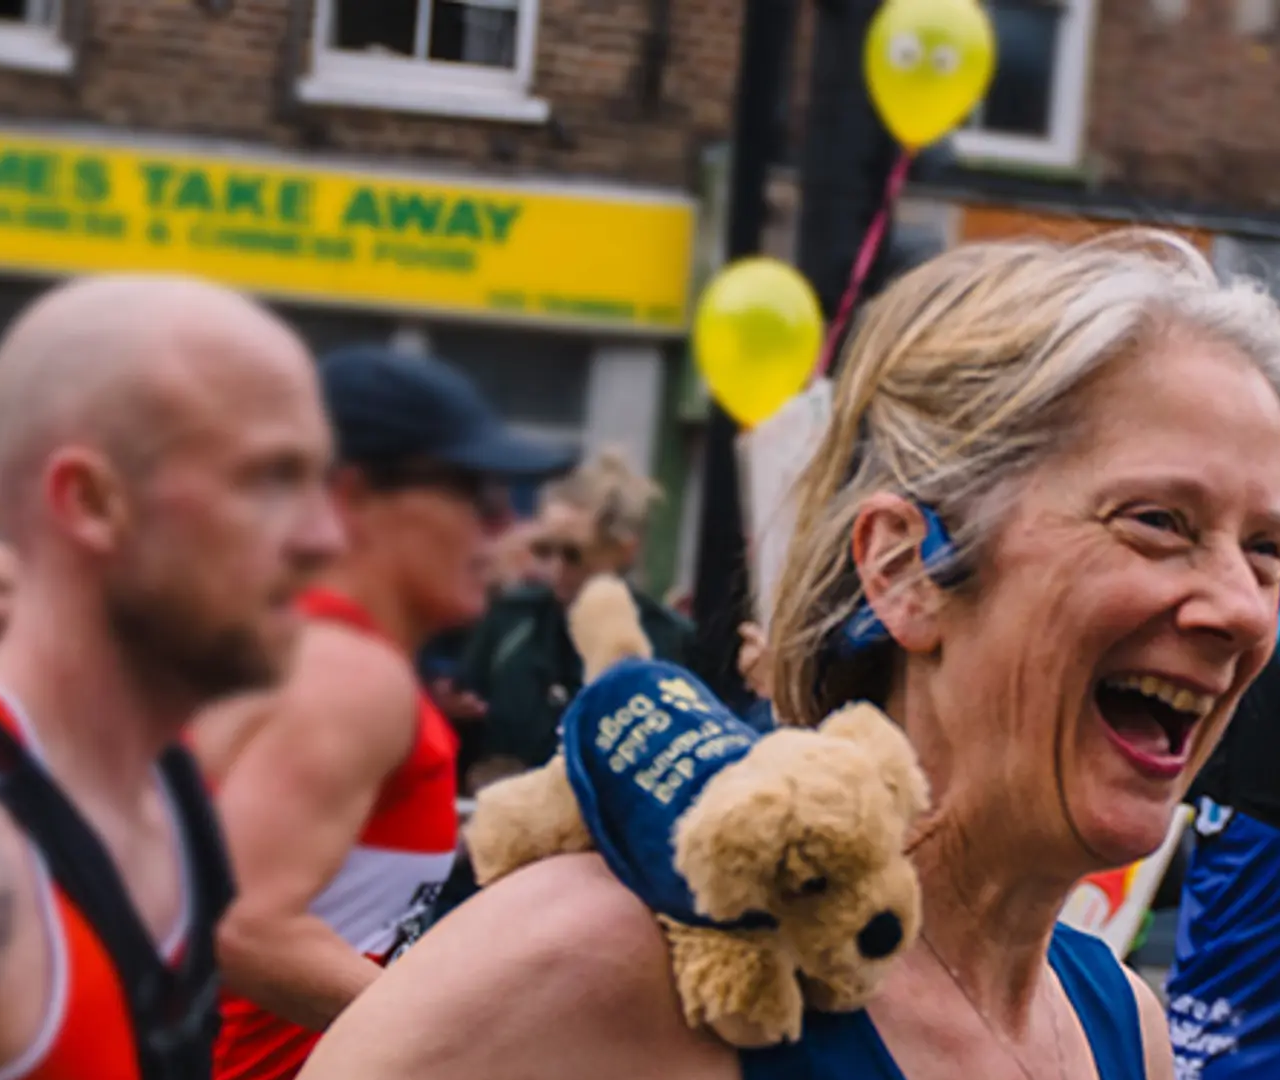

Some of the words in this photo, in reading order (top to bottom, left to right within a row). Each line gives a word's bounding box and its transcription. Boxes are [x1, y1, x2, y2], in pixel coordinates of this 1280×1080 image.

[139, 163, 314, 225] TAKE
[344, 187, 524, 246] AWAY
[189, 220, 355, 263] CHINESE
[595, 693, 655, 752] Dogs
[609, 709, 672, 773] Guide
